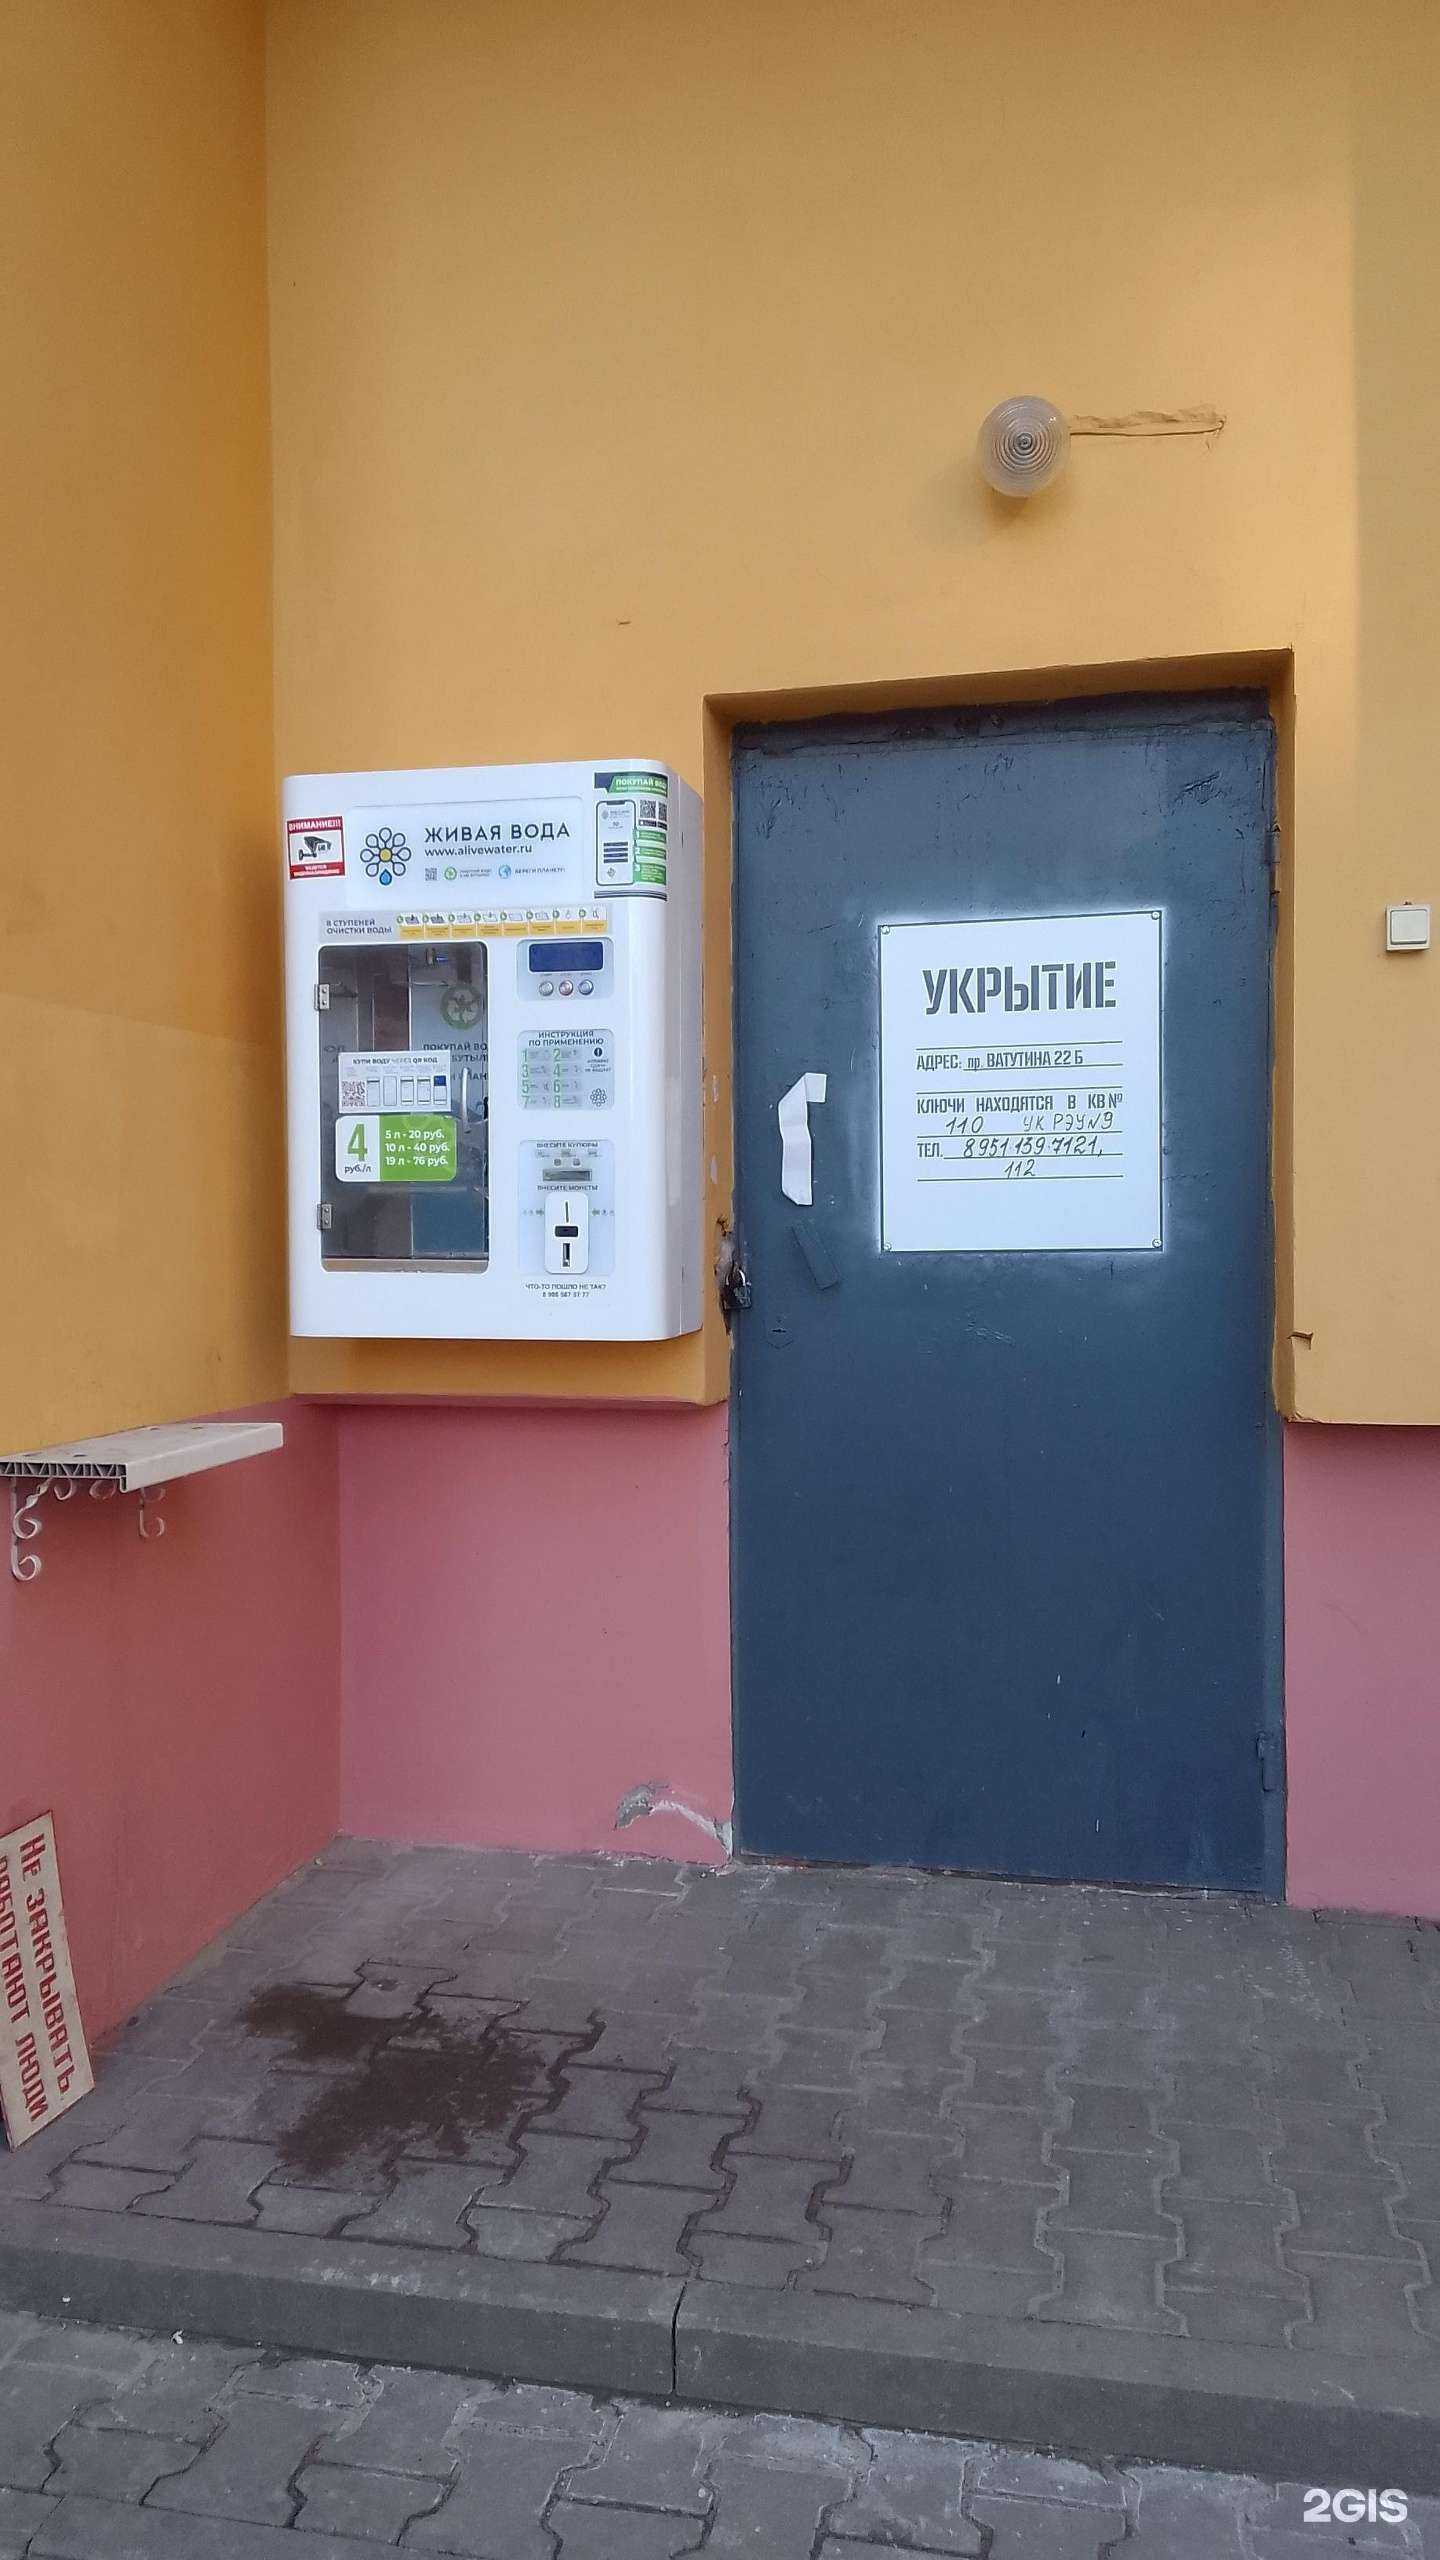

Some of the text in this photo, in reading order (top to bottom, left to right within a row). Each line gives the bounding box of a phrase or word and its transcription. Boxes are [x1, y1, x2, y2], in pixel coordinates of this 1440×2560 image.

[615, 778, 654, 786] ПОКУПАЙ
[425, 822, 570, 843] ЖИВАЯ ВОДА
[425, 844, 532, 857] www.alivewater.ru
[326, 927, 365, 935] ОЧИСТКИ
[367, 926, 392, 935] ВОДЫ
[333, 918, 375, 927] СТУПЕНЕЙ
[922, 960, 1116, 1015] УКРЫТИЕ
[528, 1038, 604, 1047] ПО ПРИМЕНЕНИЮ
[538, 1030, 594, 1039] ИНСТРУКЦИЯ
[916, 1053, 962, 1072] АДРЕС:
[968, 1056, 984, 1072] пр.
[986, 1051, 1051, 1068] ВАТУТИНА
[916, 1098, 965, 1114] КЛЮЧИ
[976, 1095, 1053, 1112] НАХОДЯТСЯ
[1067, 1095, 1076, 1110] В
[945, 1116, 984, 1134] 110
[385, 1129, 392, 1139] 5
[394, 1131, 400, 1139] л
[408, 1129, 421, 1139] 20
[424, 1128, 445, 1141] руб.
[347, 1124, 368, 1162] 4
[385, 1143, 396, 1152] 10
[413, 1142, 427, 1152] 40
[429, 1142, 450, 1153] руб.
[916, 1142, 943, 1158] ТЕЛ.
[385, 1156, 396, 1166] 19
[398, 1158, 405, 1166] л
[413, 1156, 425, 1166] 76
[427, 1155, 448, 1167] руб.
[1004, 1159, 1035, 1178] 112
[26, 1888, 76, 2095] ЗАКРЫВАТЬ
[15, 2031, 48, 2122] ЛЮДИ
